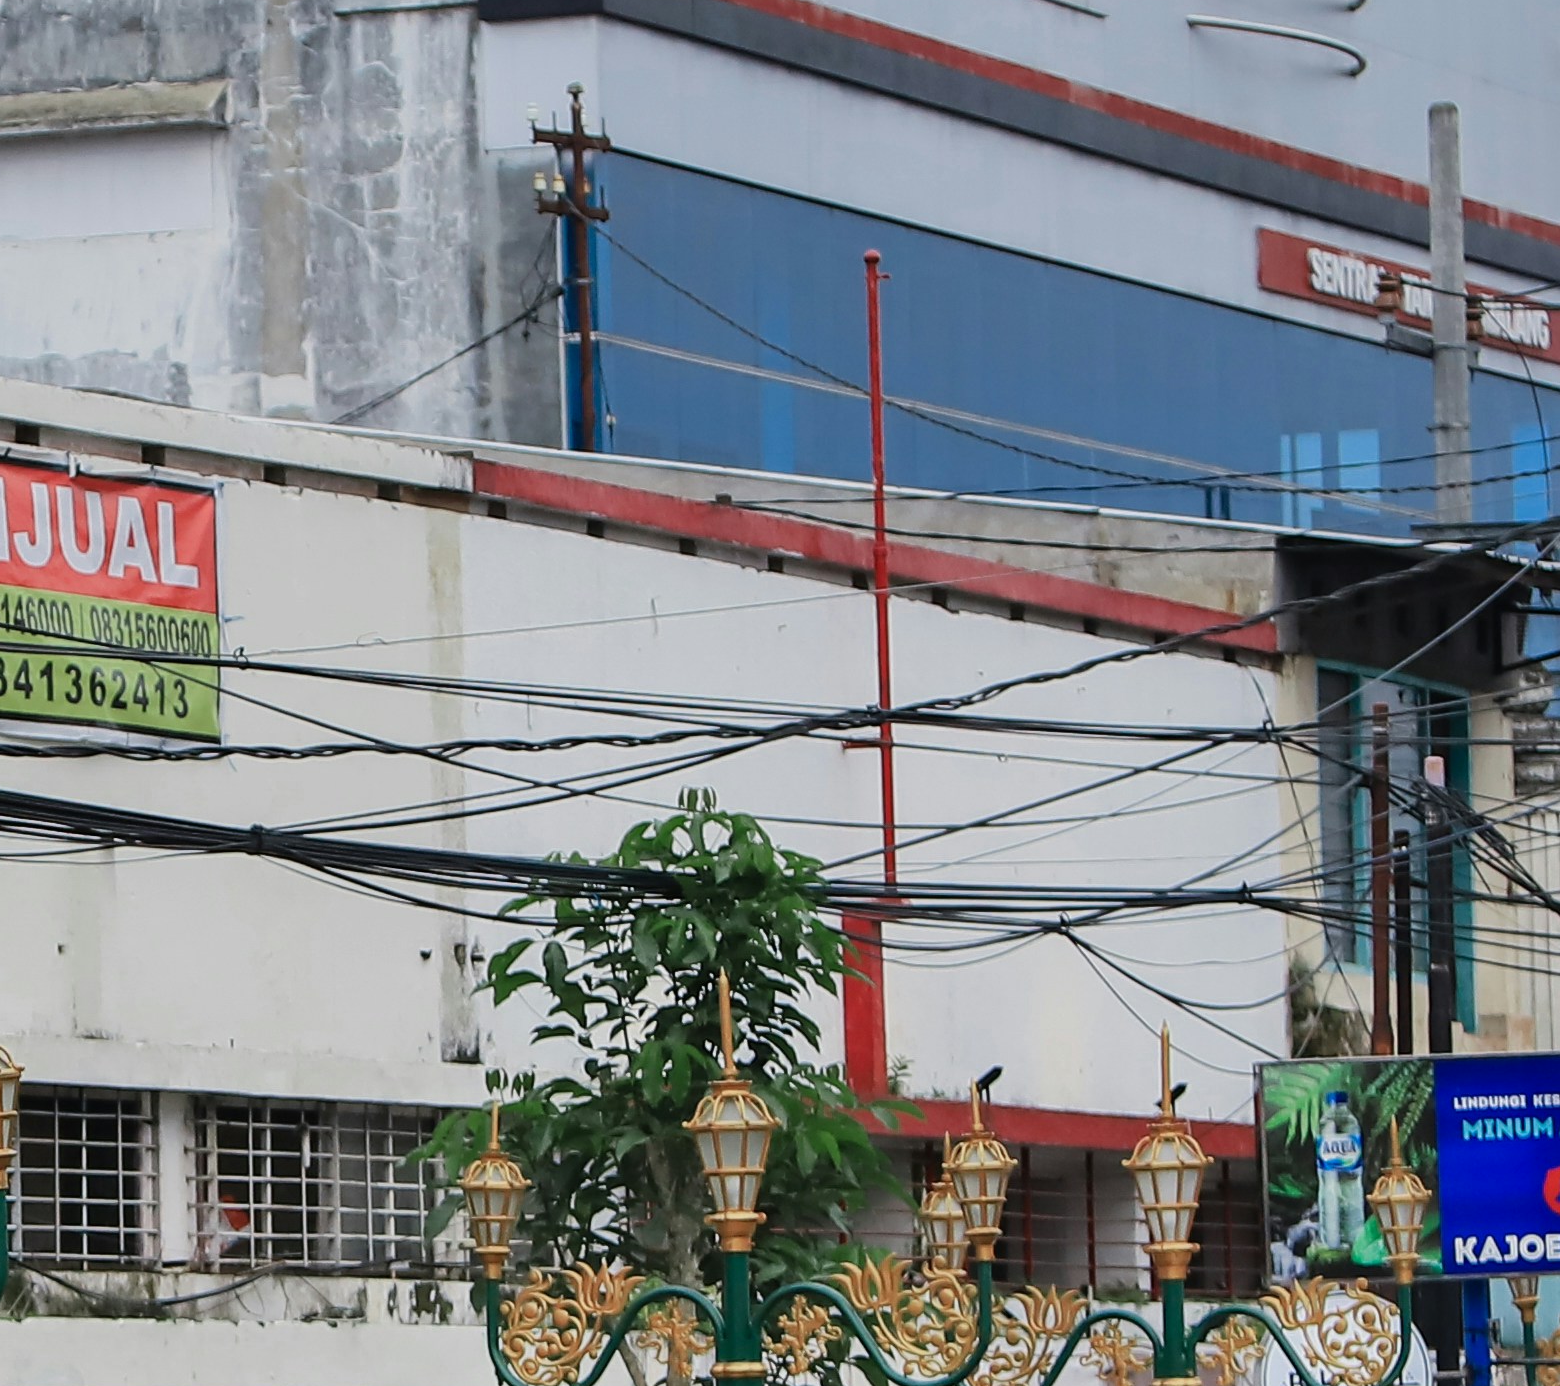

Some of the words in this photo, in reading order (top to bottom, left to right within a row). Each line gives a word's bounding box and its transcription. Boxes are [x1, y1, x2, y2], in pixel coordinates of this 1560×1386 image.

[1307, 248, 1396, 305] SENTRA
[1453, 1095, 1527, 1111] LINDUNGI
[1462, 1116, 1554, 1141] MINUM
